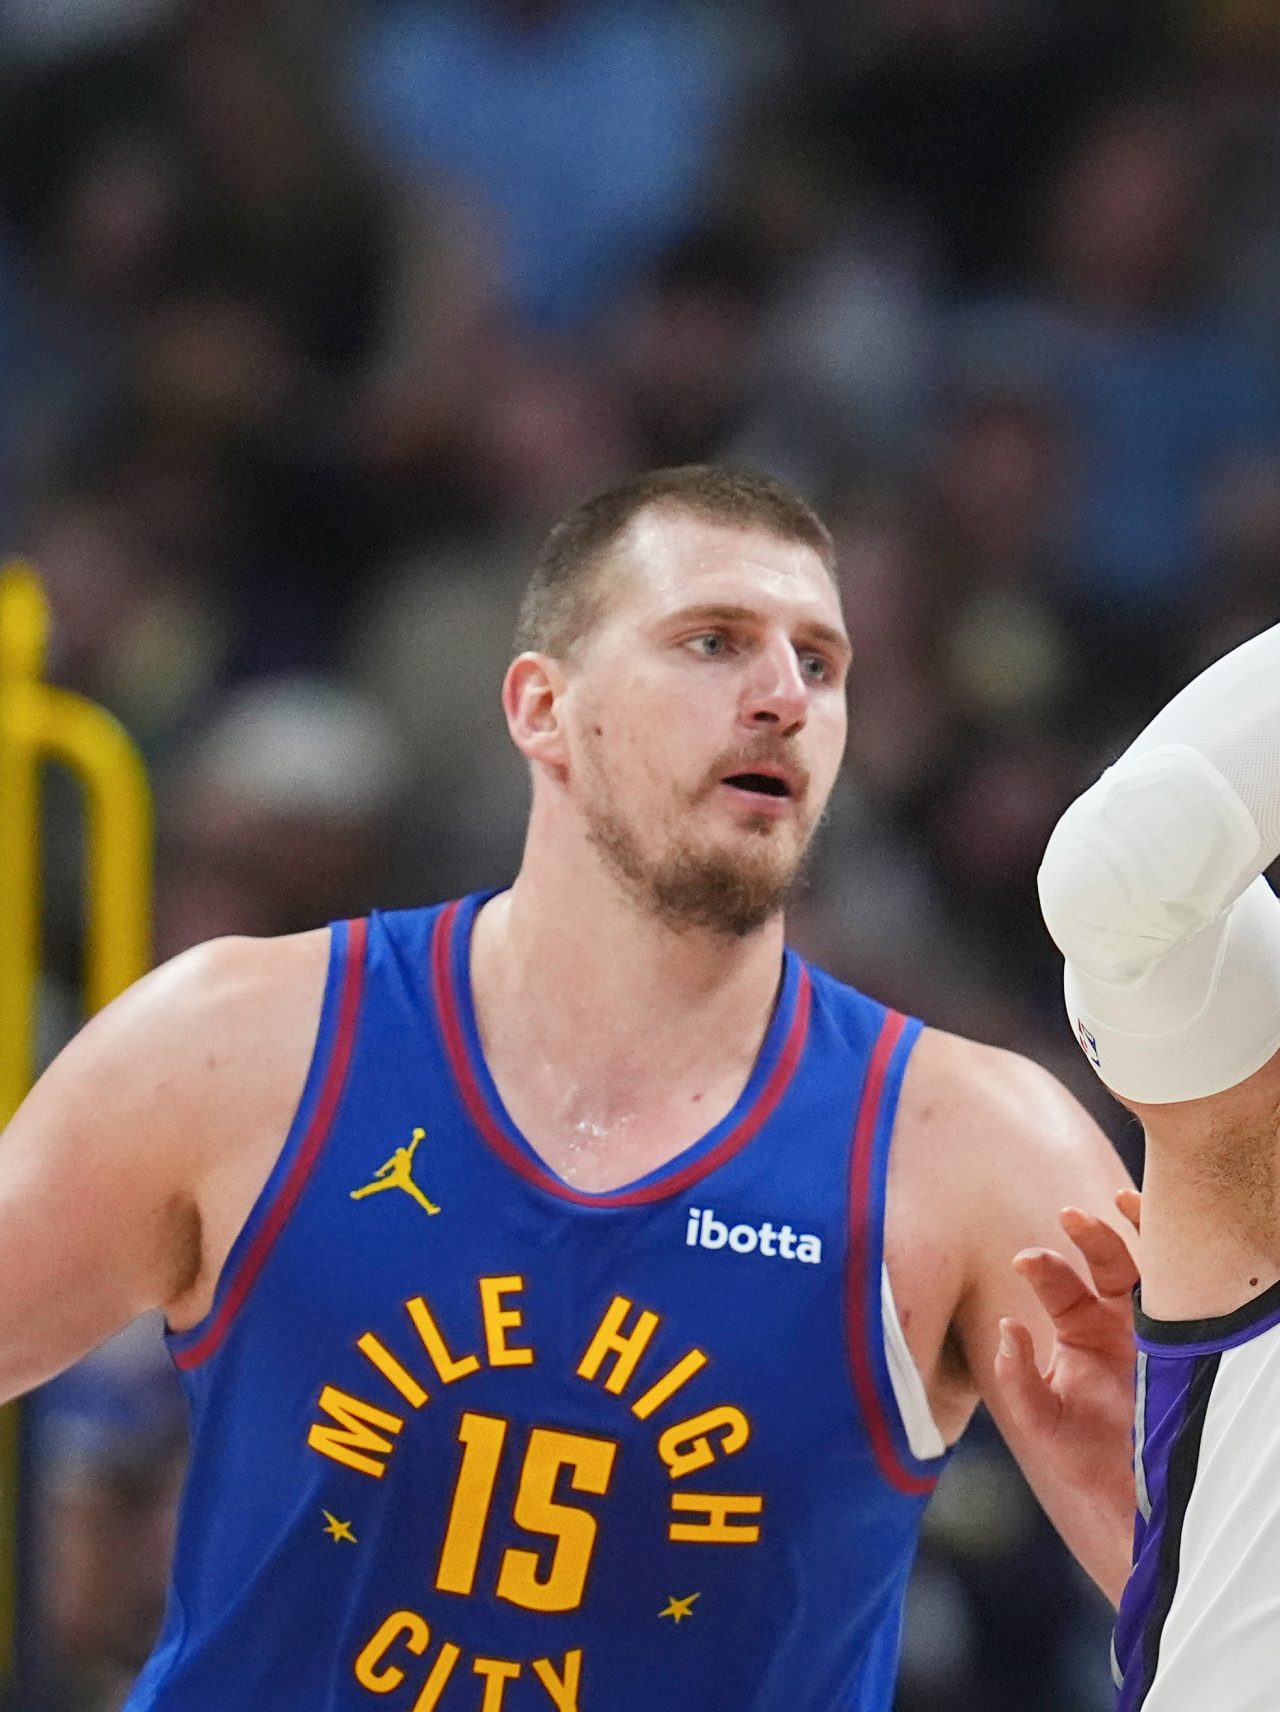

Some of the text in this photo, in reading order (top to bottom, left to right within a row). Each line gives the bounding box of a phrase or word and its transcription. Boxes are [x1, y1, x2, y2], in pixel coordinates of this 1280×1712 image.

[686, 1207, 822, 1264] ibotta
[306, 1274, 763, 1543] MILE HIGH
[435, 1412, 618, 1613] 15
[354, 1609, 582, 1712] CITY
